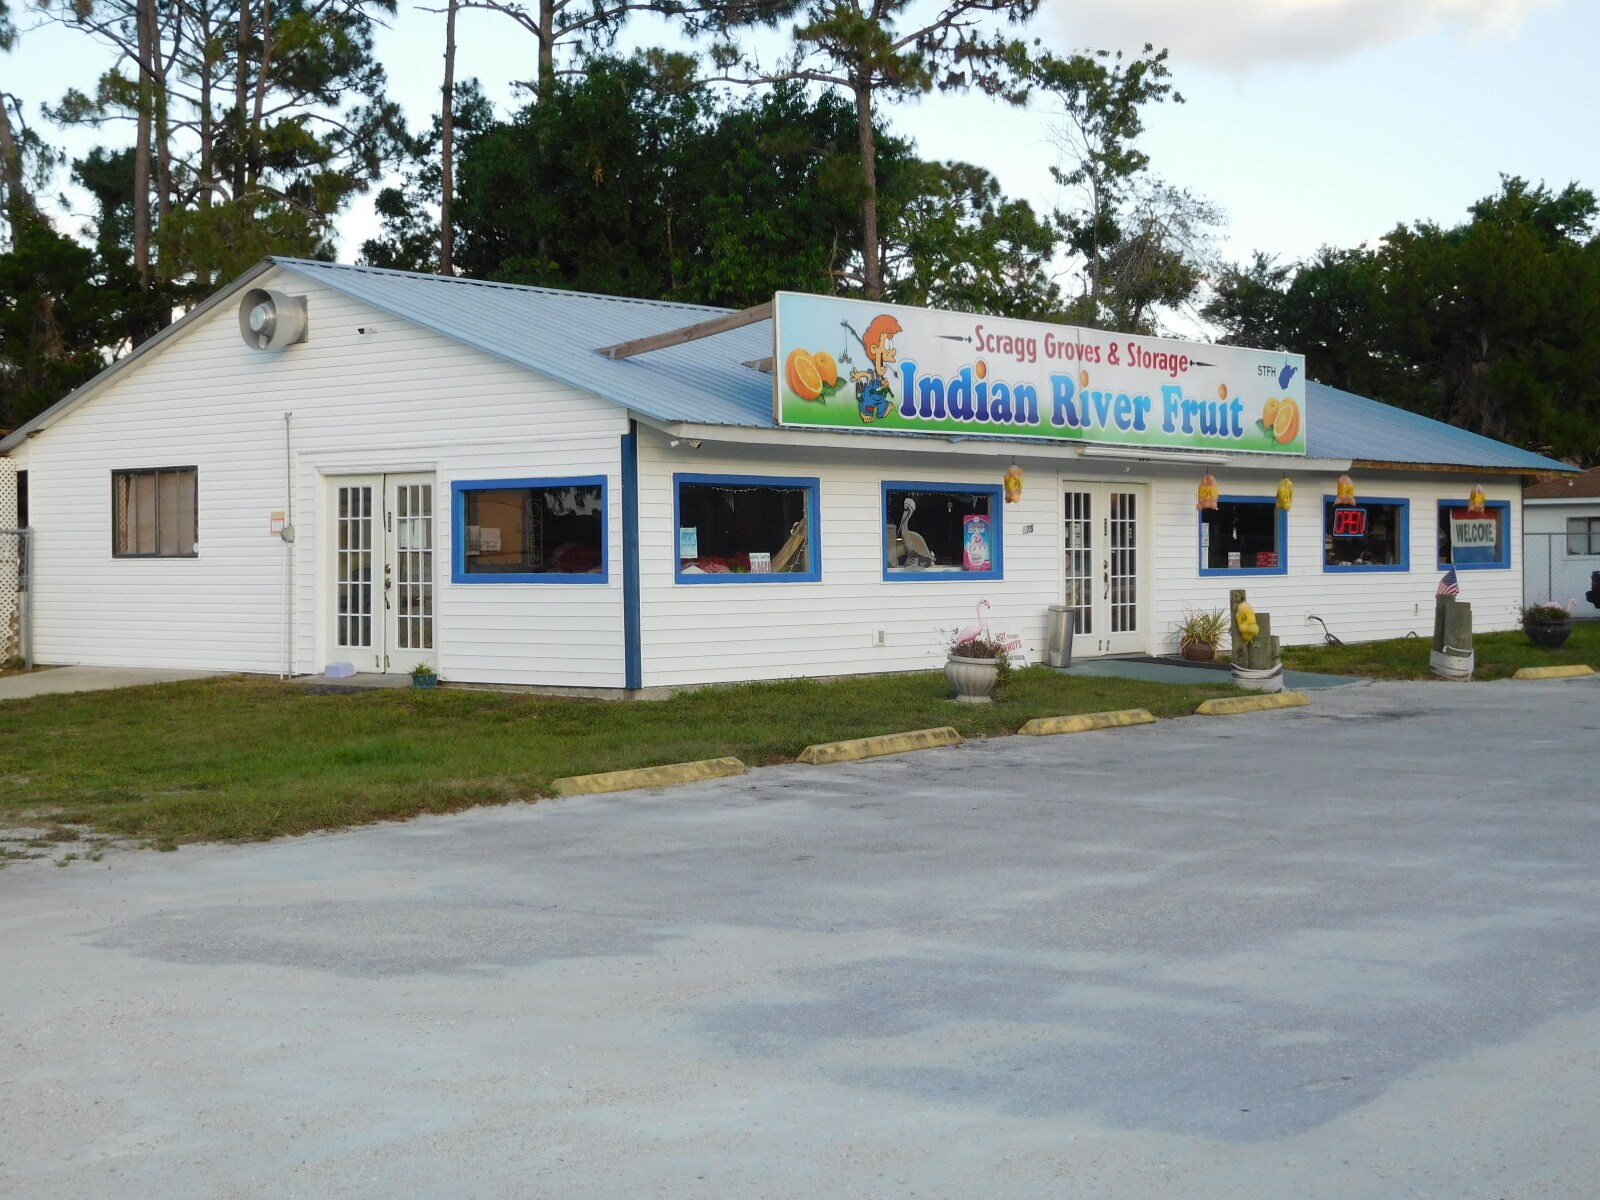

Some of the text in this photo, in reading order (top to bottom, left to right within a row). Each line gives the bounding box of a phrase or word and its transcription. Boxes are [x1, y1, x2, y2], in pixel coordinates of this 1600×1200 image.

[974, 324, 1188, 377] Scragg Groves & Storage
[1257, 364, 1277, 377] STFH
[899, 360, 1244, 438] Indian River Fruit
[1335, 510, 1367, 535] OPEN
[1455, 522, 1495, 543] WELCOME
